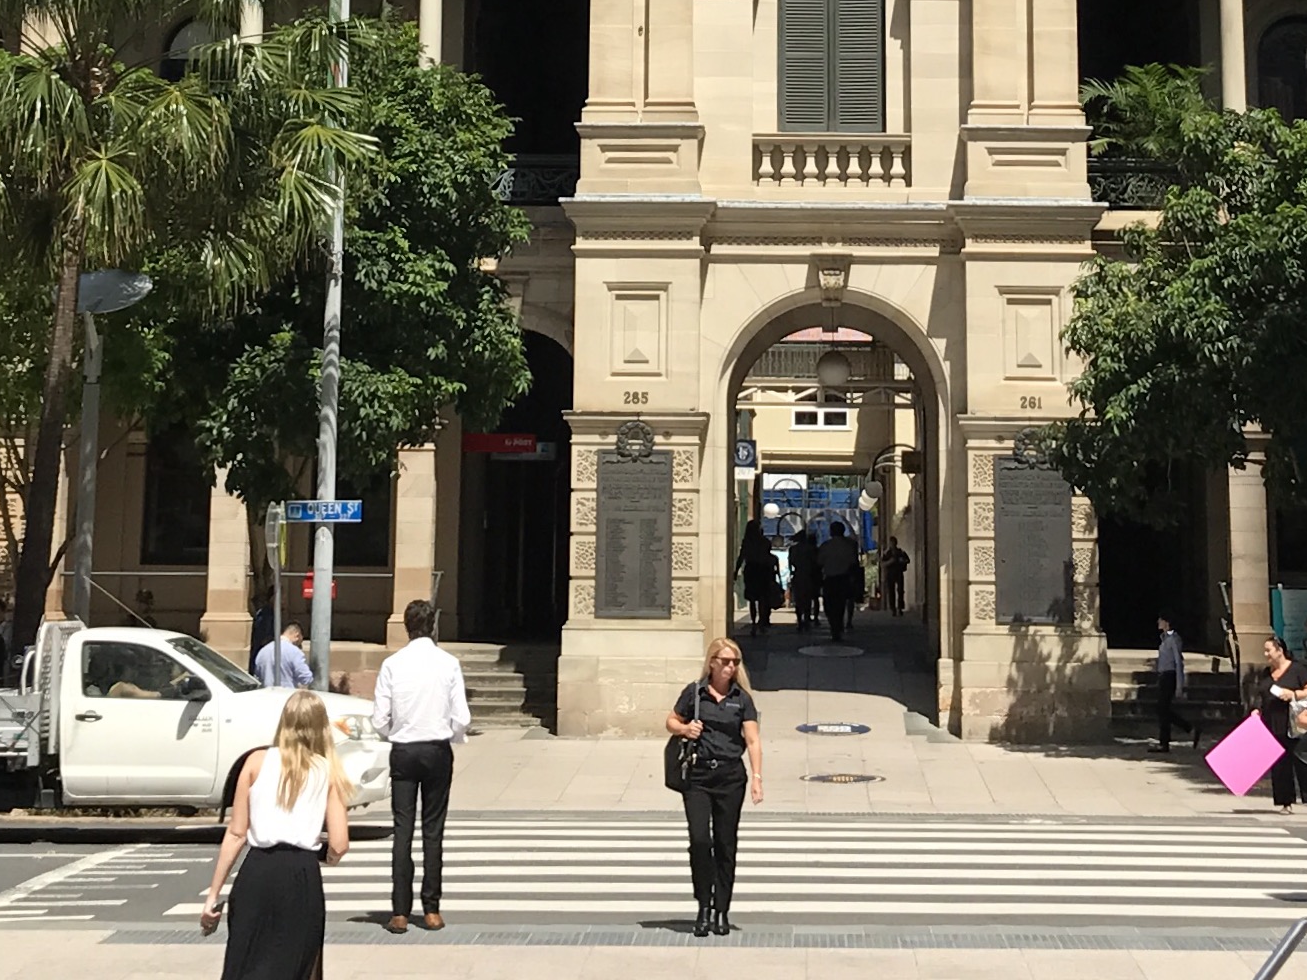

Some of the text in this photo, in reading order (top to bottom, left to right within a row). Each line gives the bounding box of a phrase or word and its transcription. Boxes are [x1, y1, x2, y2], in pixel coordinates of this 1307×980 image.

[623, 391, 649, 405] 285
[1019, 396, 1043, 409] 261
[306, 502, 342, 515] QUEEN
